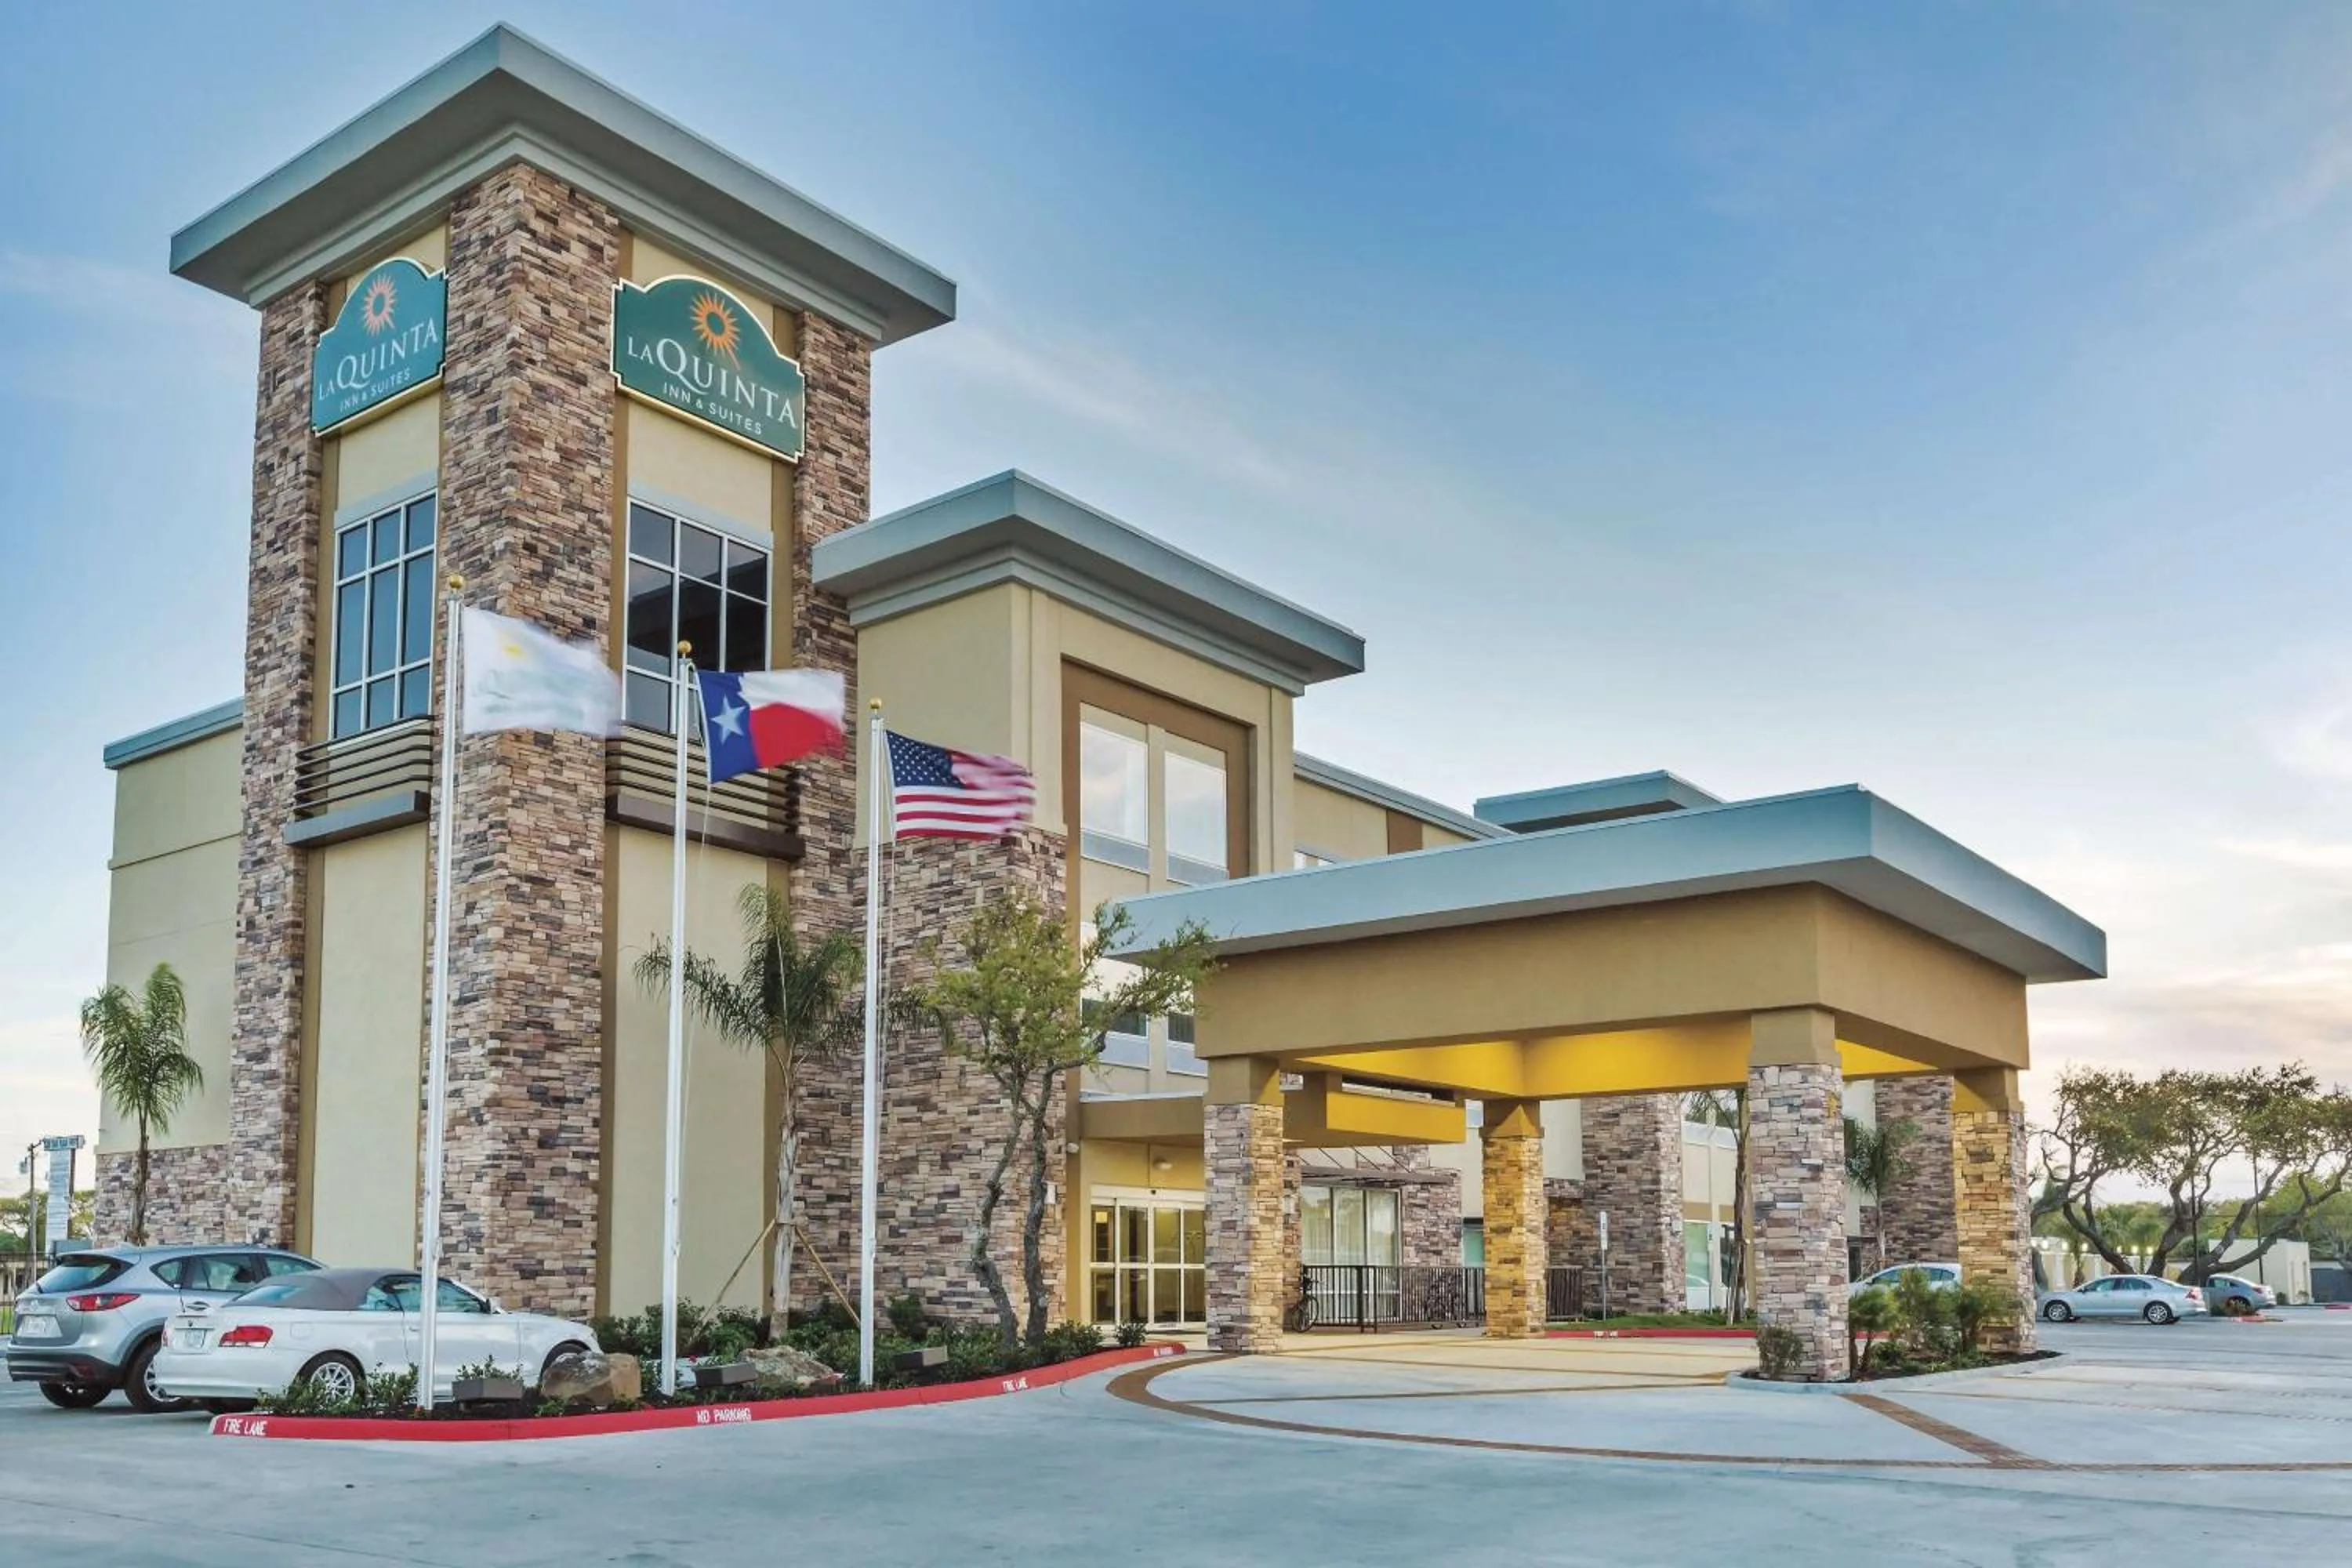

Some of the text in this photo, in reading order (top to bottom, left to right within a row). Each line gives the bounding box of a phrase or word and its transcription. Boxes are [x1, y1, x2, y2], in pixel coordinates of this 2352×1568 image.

[319, 317, 438, 401] LA QUINTA
[628, 336, 798, 429] LA QUINTA
[339, 392, 358, 412] INN
[371, 367, 411, 397] SUITES
[662, 382, 762, 436] INN & SUITES
[697, 1407, 752, 1424] NO PARKING
